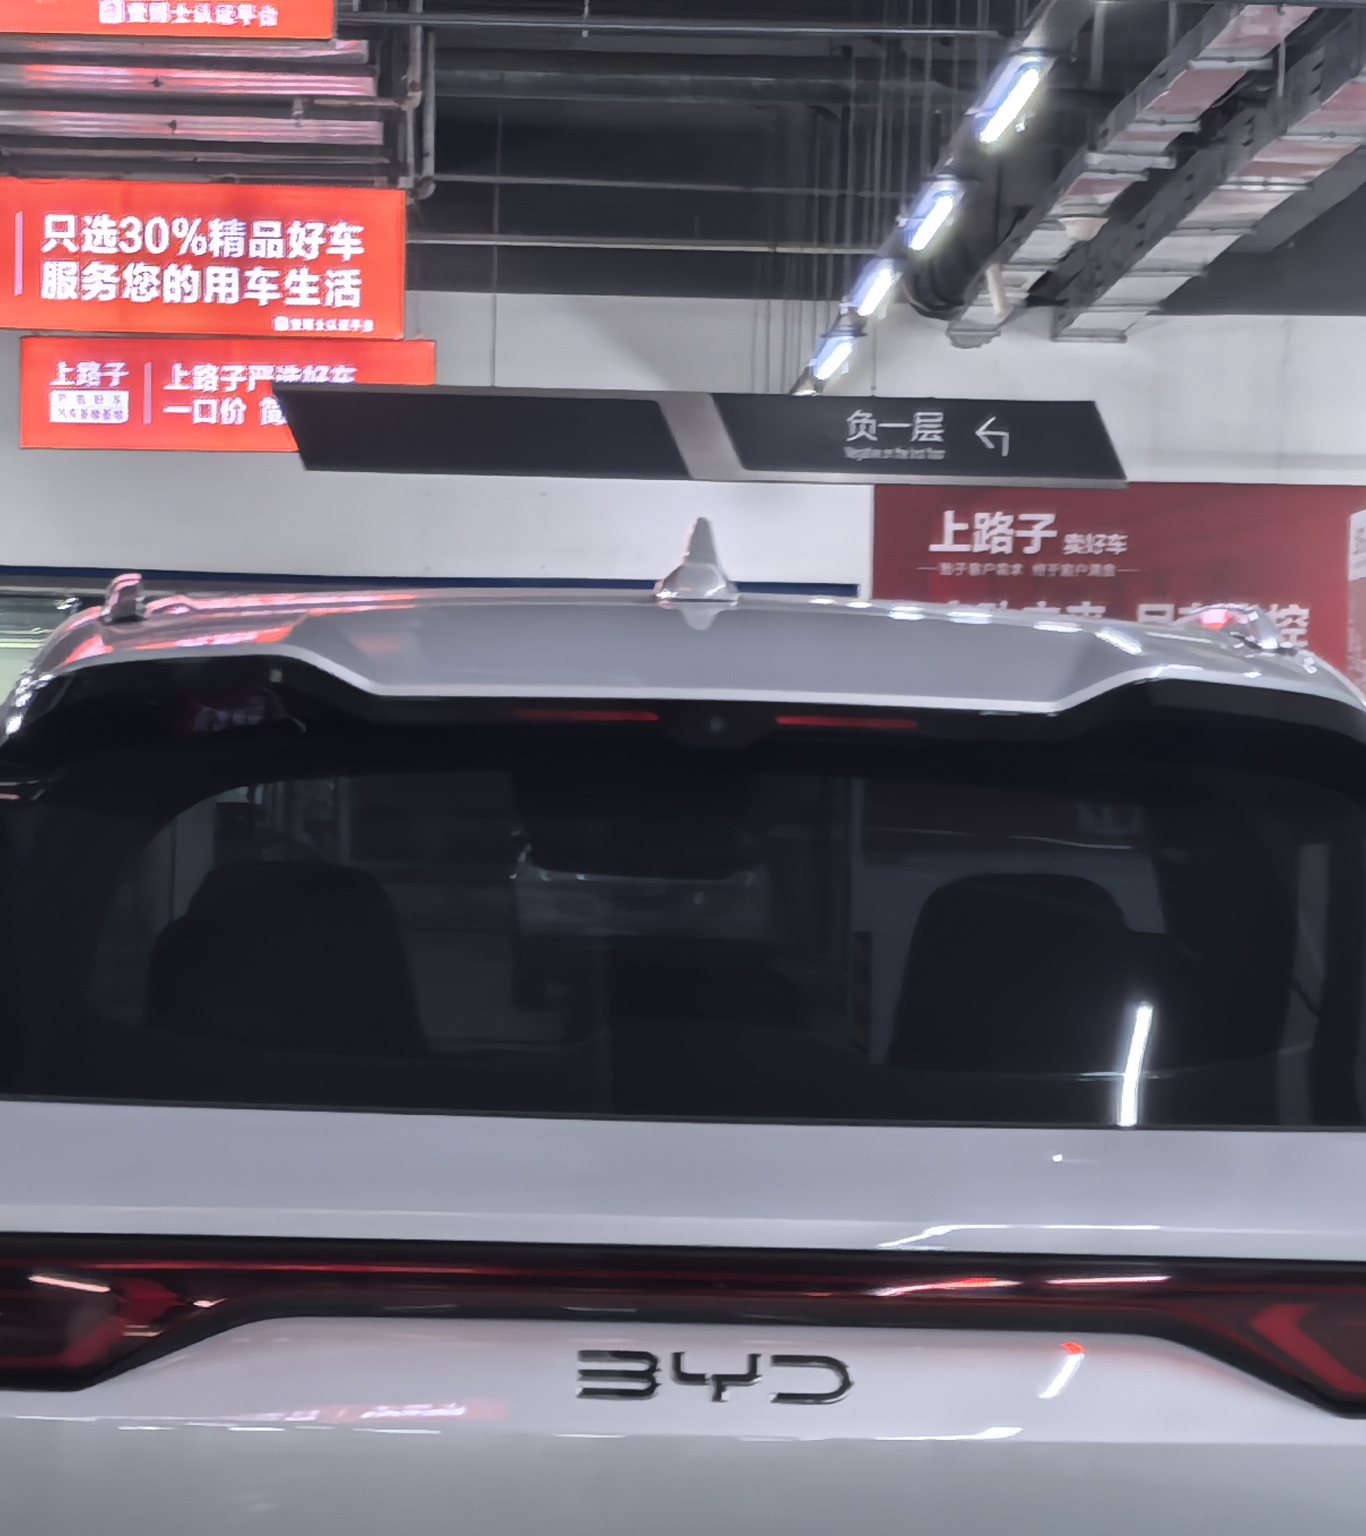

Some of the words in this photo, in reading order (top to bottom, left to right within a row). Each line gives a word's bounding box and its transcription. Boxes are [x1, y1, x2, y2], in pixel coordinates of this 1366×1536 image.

[40, 213, 365, 261] 只选30%精品好车
[40, 261, 363, 308] 服务您的用车生活
[49, 361, 129, 388] 上路子
[163, 397, 247, 427] 一口价
[845, 409, 945, 442] 负一层
[928, 509, 1059, 555] 上路子
[576, 1350, 854, 1405] BYD
